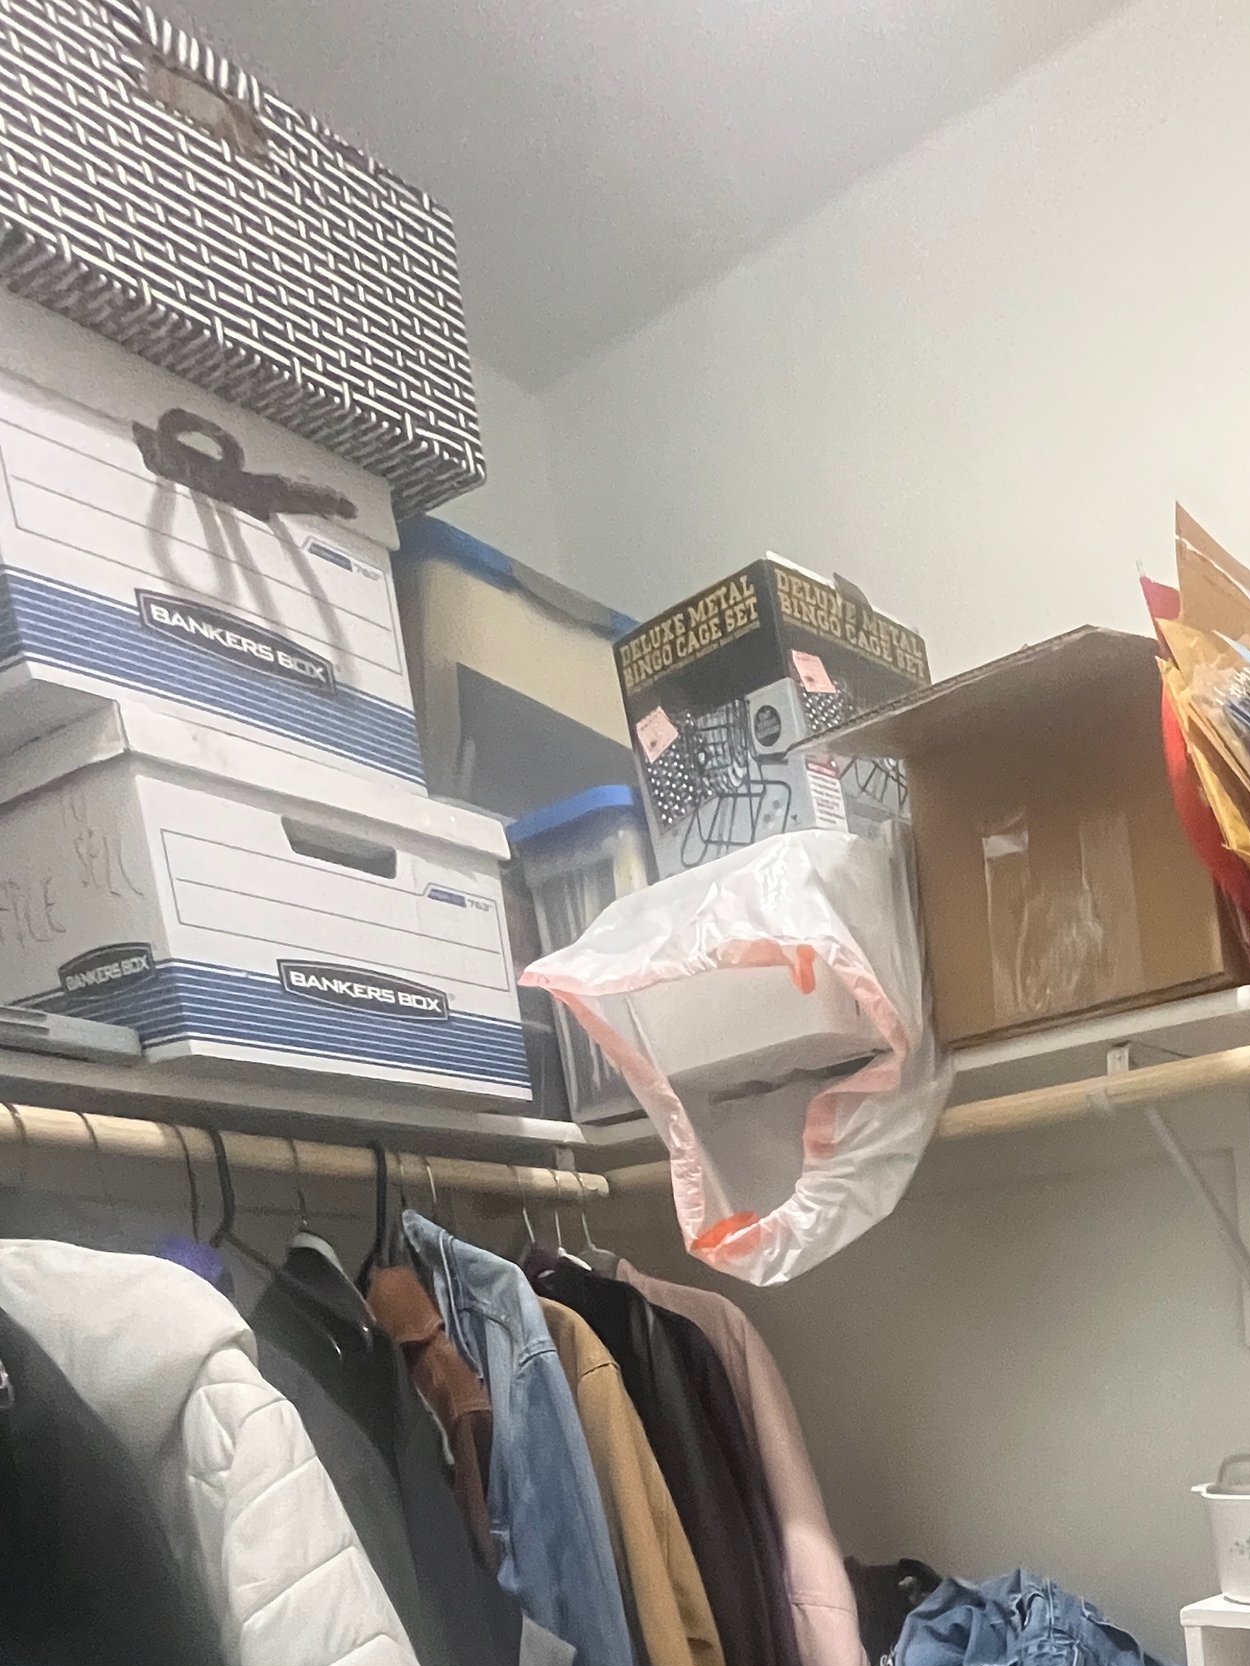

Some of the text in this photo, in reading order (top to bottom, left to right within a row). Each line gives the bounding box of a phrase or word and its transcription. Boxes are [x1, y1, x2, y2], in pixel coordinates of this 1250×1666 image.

[150, 603, 328, 683] BANKERS BOX
[620, 613, 686, 666] DELUXE
[687, 574, 756, 629] METAL
[622, 644, 674, 688] BINGO
[676, 620, 722, 657] CAGE
[724, 595, 758, 632] SET
[780, 591, 842, 643] BINGO
[845, 622, 893, 664] CAGE
[65, 953, 151, 992] BANKERS BOX
[289, 970, 443, 1014] BANKERS BOX
